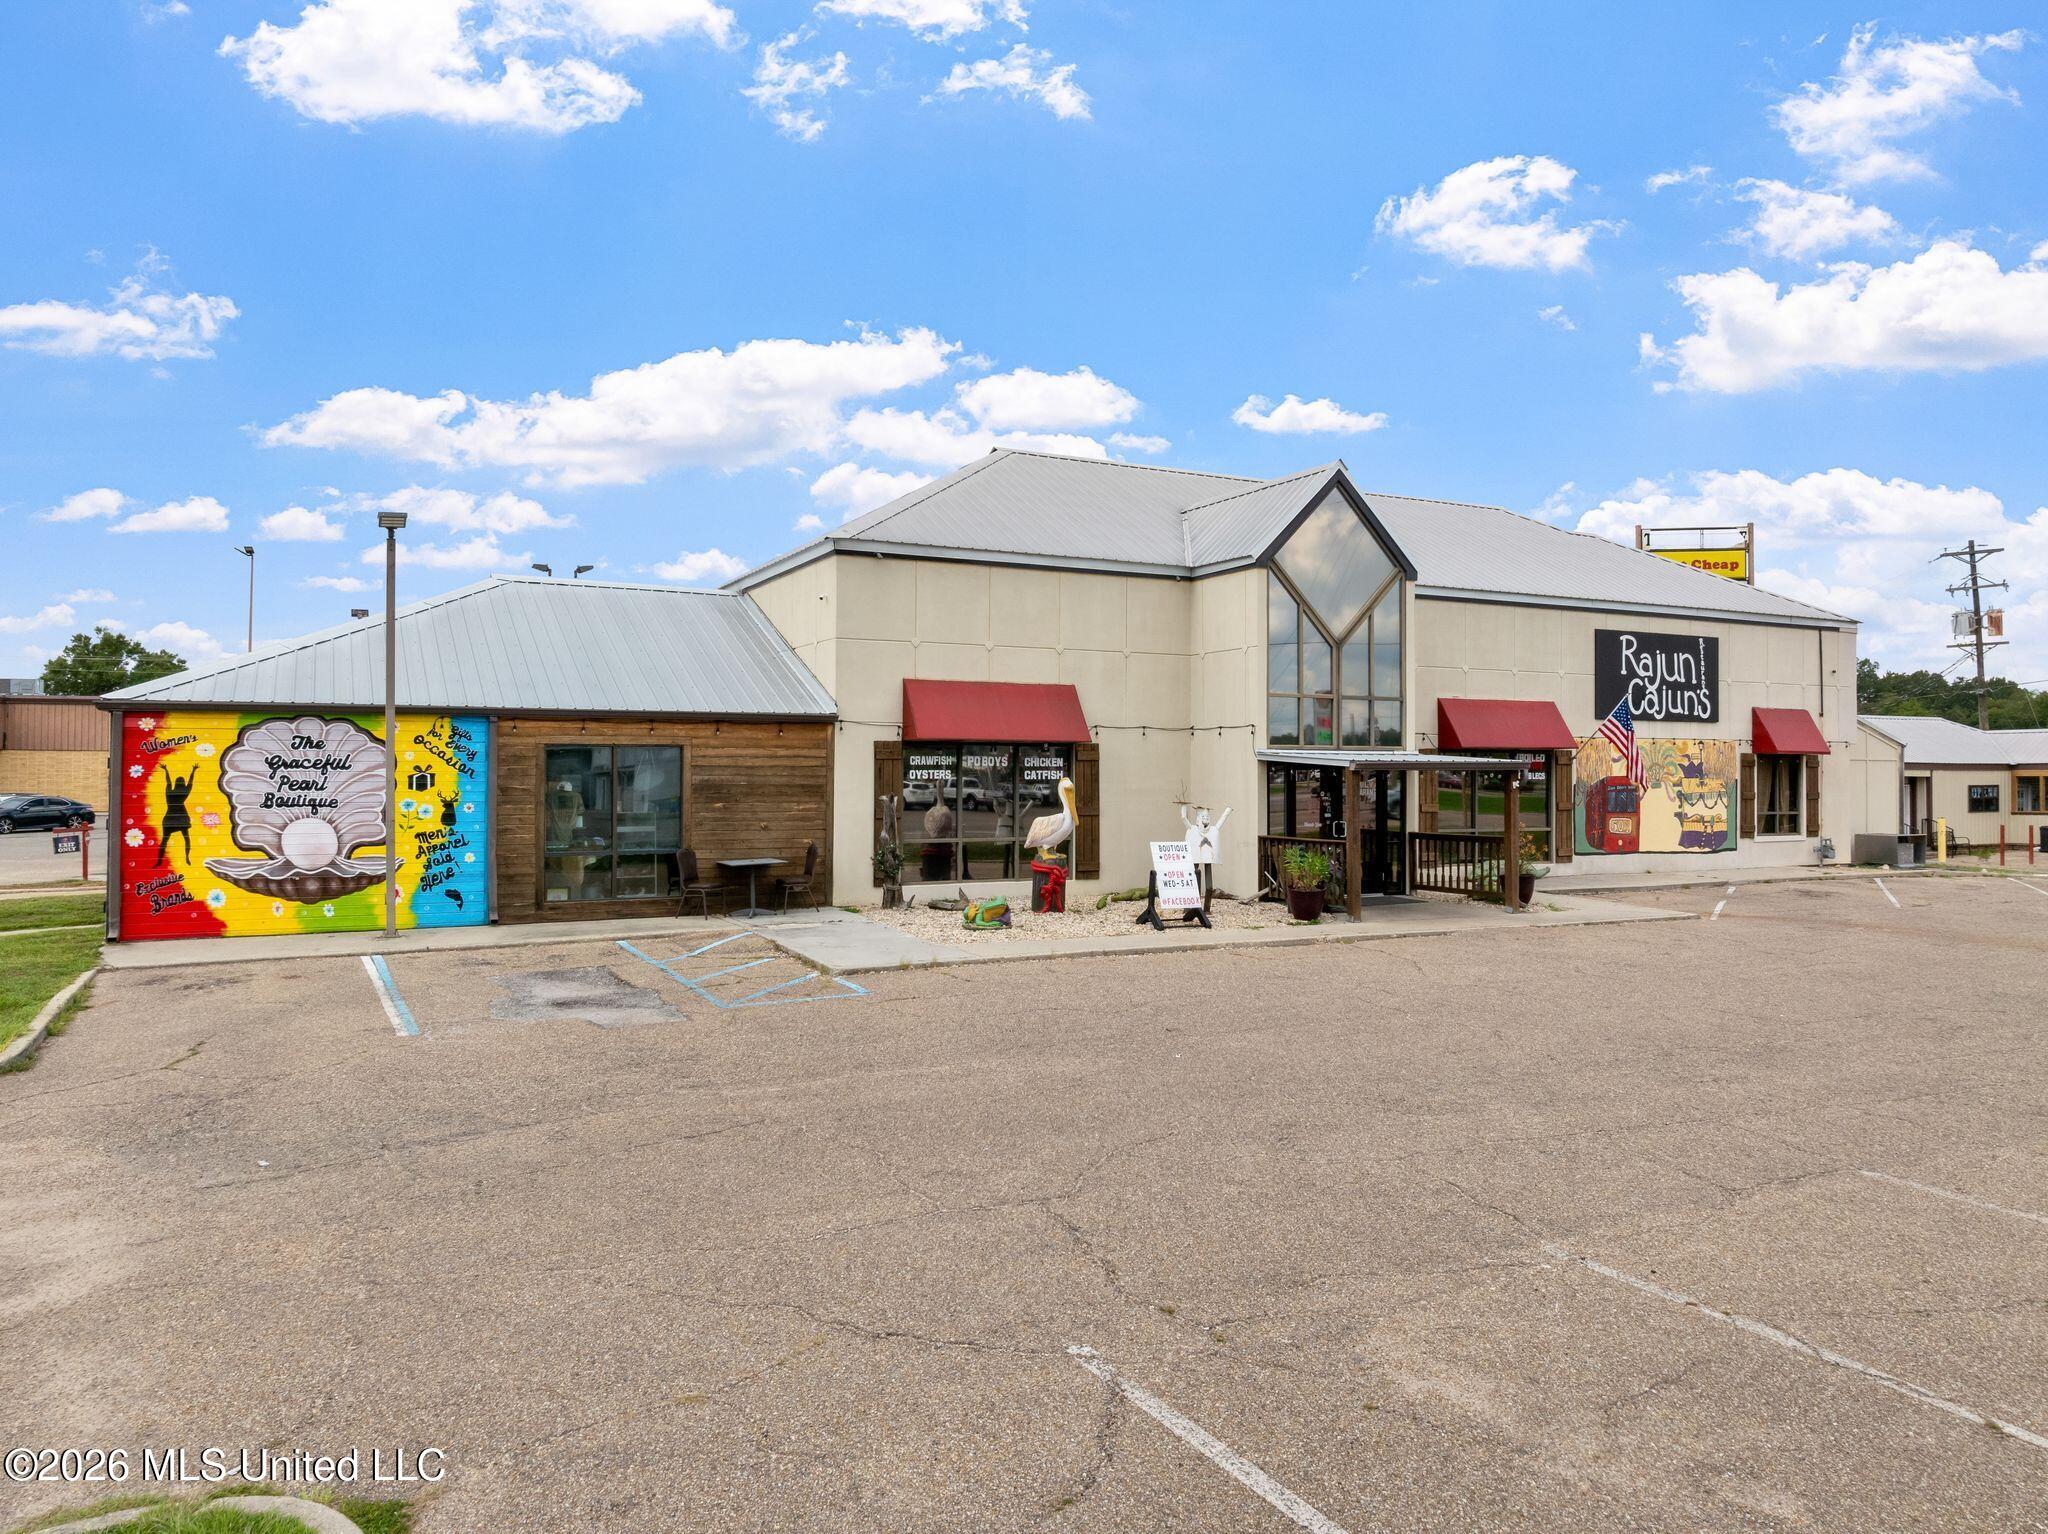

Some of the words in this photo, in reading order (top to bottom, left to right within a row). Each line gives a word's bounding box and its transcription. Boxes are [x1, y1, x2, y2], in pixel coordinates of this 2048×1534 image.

[1691, 559, 1739, 571] Cheap
[1619, 634, 1697, 690] Rajun
[448, 724, 472, 741] Gifts
[141, 734, 198, 753] Women's
[291, 735, 326, 750] The
[445, 739, 478, 762] Every
[413, 734, 475, 779] Occasion
[909, 755, 952, 765] CRAWFISH
[1024, 757, 1063, 767] CHICKEN
[264, 753, 352, 780] Graceful
[909, 769, 952, 779] OYSTERS
[1024, 770, 1063, 780] CATFISH
[277, 775, 328, 792] Pearl
[259, 792, 339, 815] Boutique
[414, 827, 458, 844] Men's
[415, 834, 470, 859] Apparel
[1158, 844, 1189, 853] BOUTIQUE
[423, 851, 455, 872] Sold
[1163, 853, 1181, 861] OPEN
[1163, 879, 1194, 888] WED-SAT
[1167, 871, 1185, 879] OPEN
[150, 887, 194, 915] Brands
